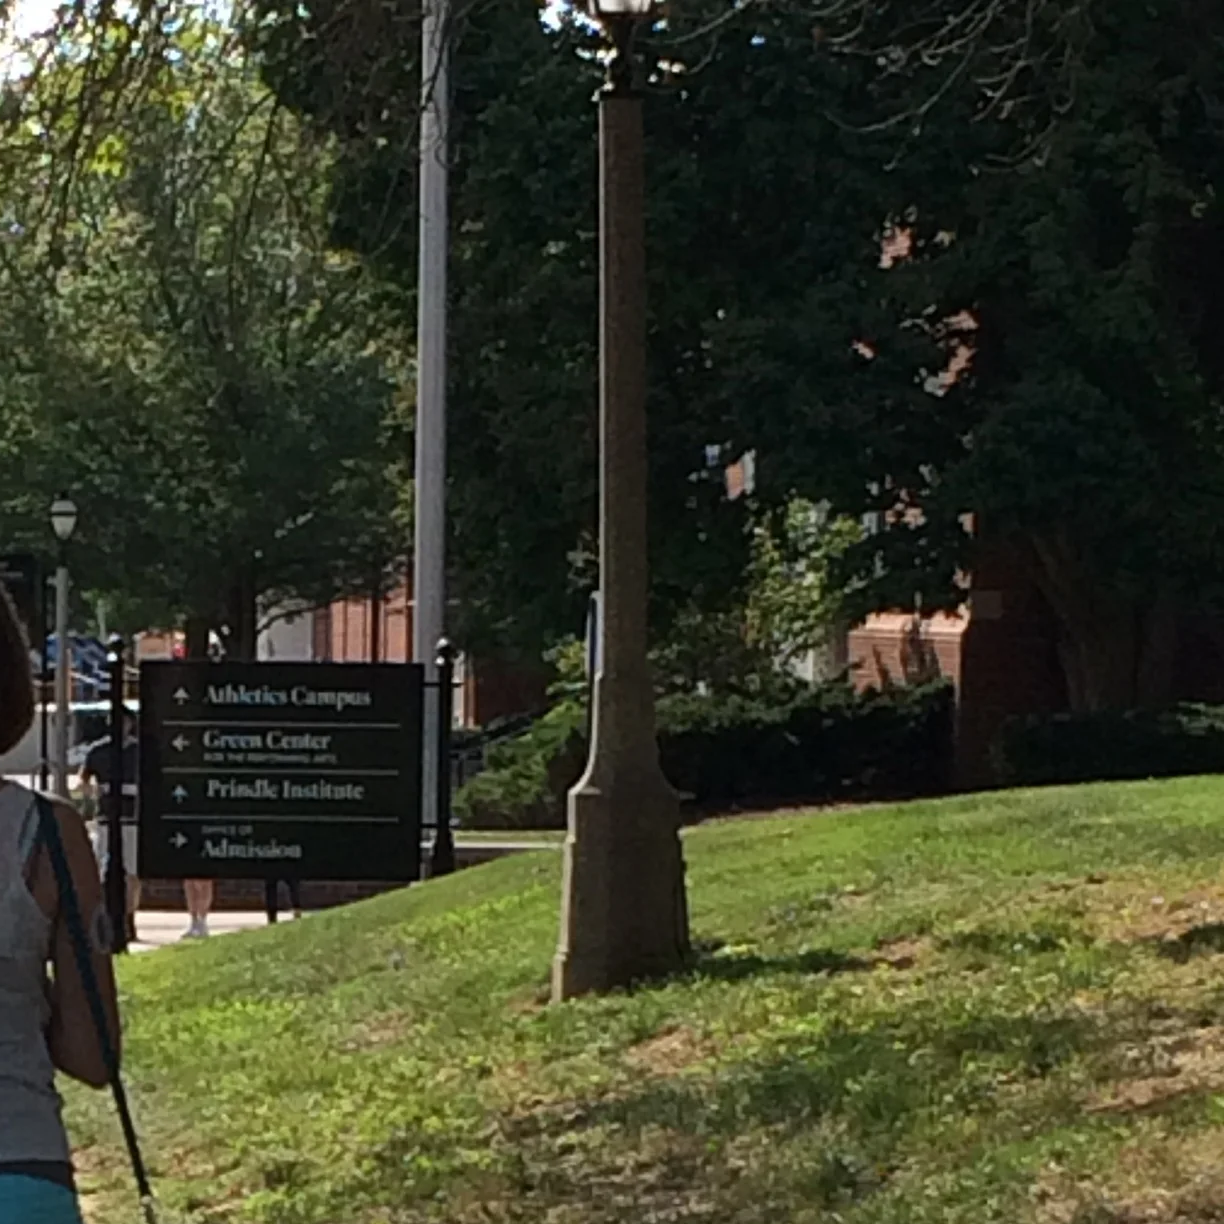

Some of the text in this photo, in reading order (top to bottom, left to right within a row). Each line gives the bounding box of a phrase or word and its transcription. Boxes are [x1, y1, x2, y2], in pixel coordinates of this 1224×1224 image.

[204, 684, 372, 711] Athletics Campus
[202, 730, 332, 750] Green Center
[206, 779, 365, 800] Prindle Institute
[202, 838, 303, 859] Admission
